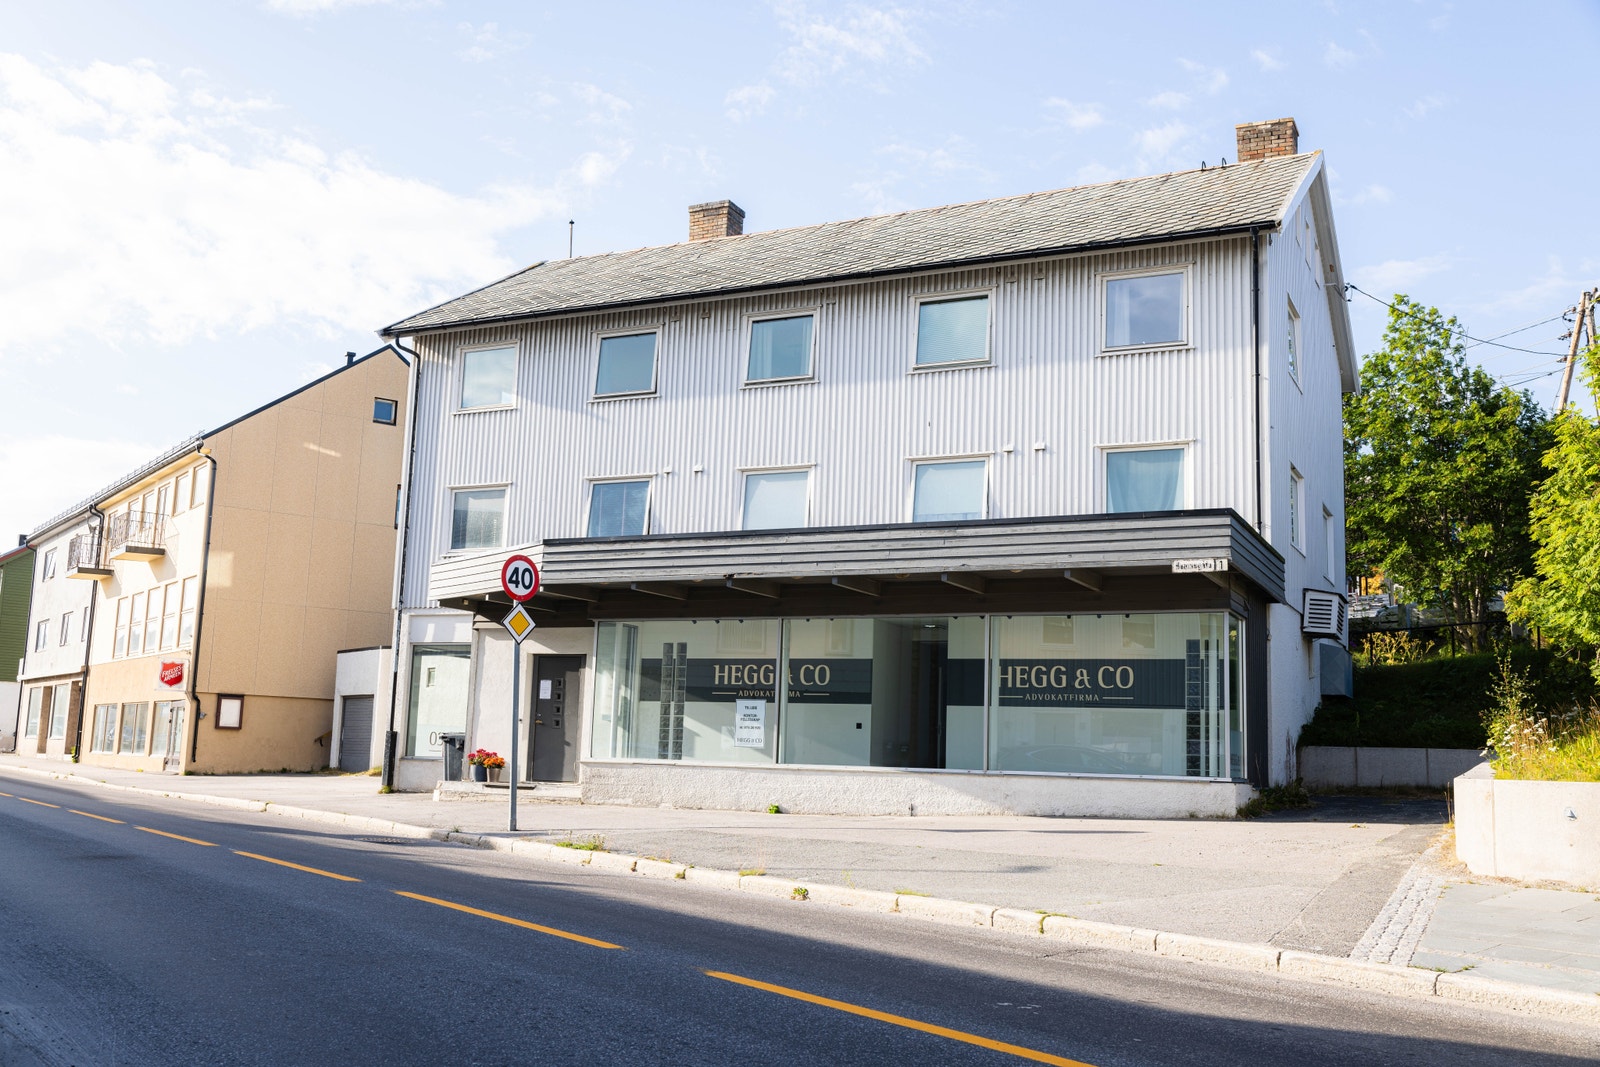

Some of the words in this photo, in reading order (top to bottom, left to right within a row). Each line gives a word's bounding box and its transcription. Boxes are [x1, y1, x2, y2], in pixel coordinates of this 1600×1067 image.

[507, 566, 534, 590] 40
[713, 664, 774, 685] HEGG
[799, 664, 831, 686] CO
[999, 665, 1067, 688] HEGG
[1074, 668, 1092, 689] &
[1097, 665, 1135, 689] CO
[738, 690, 801, 698] ADVOKATMA
[1025, 693, 1100, 701] ADVOKATFIRMA
